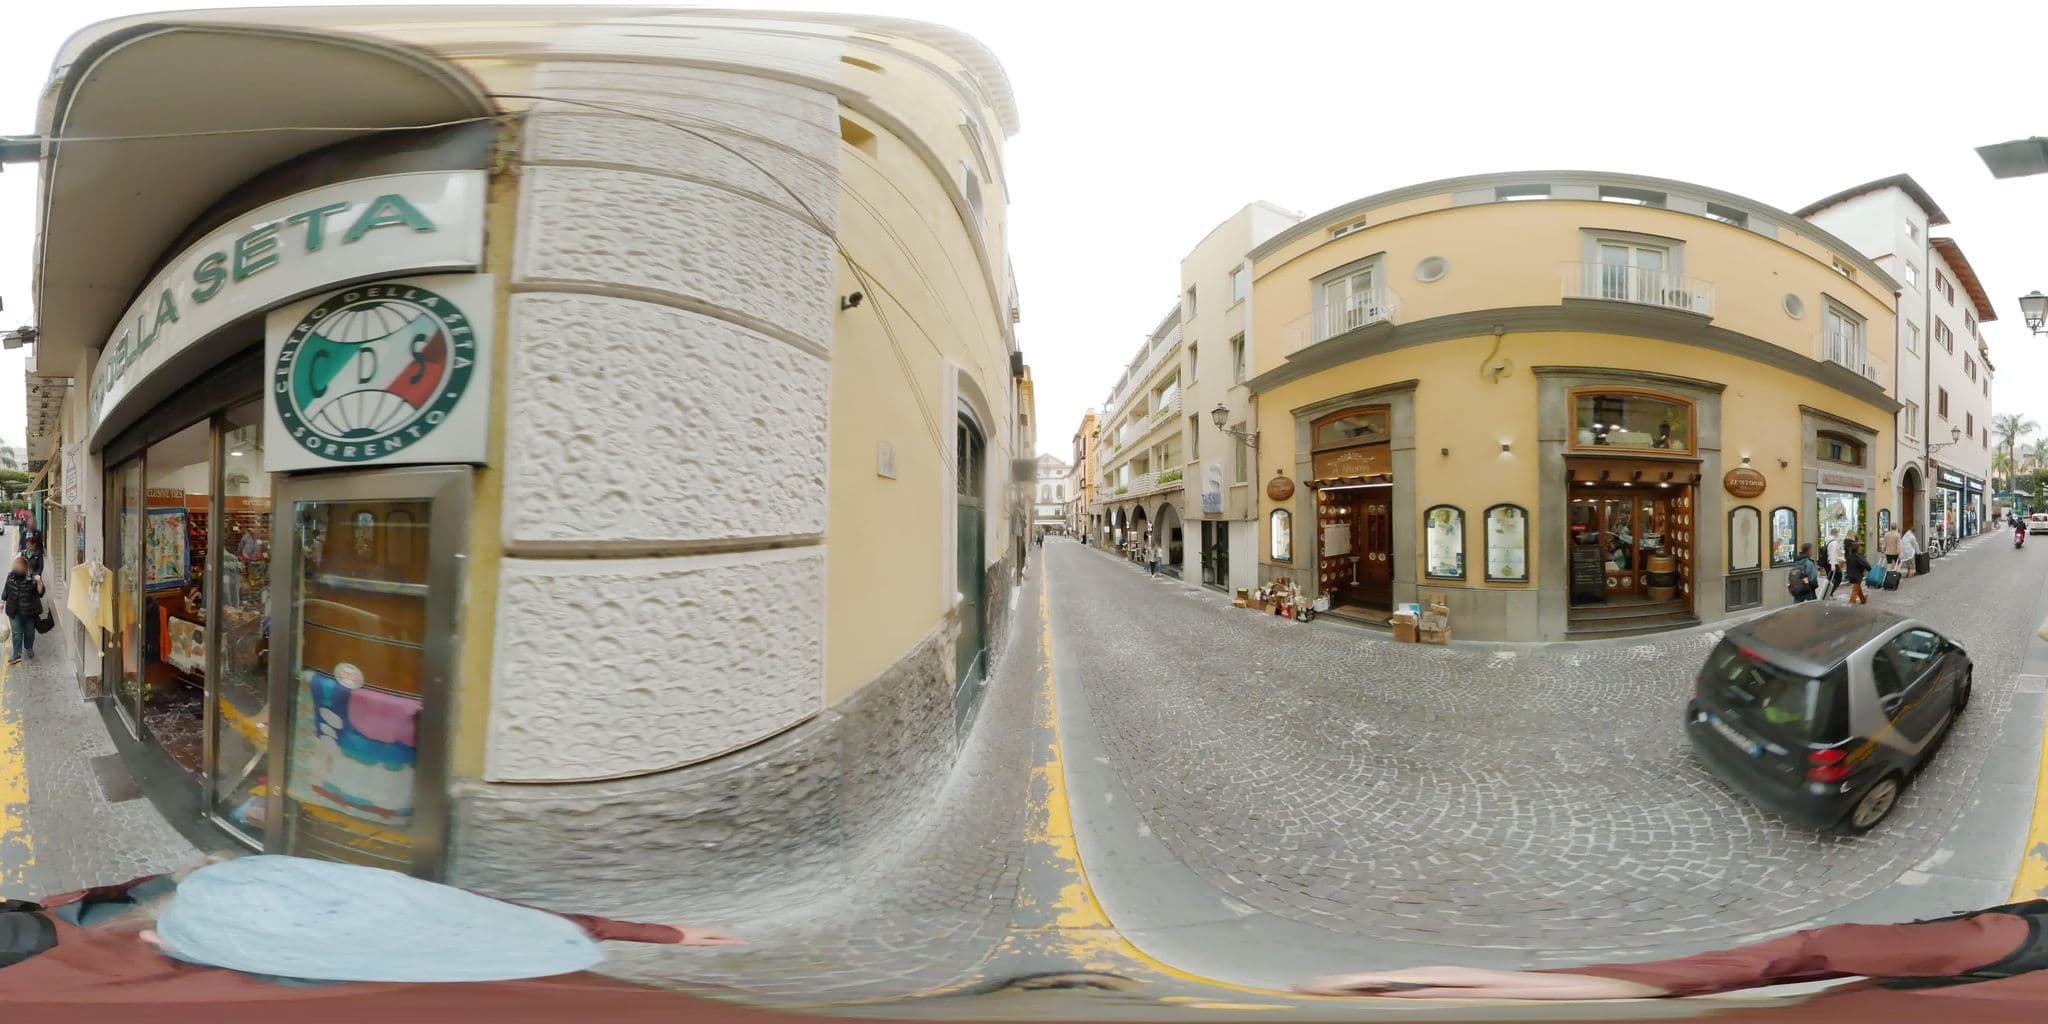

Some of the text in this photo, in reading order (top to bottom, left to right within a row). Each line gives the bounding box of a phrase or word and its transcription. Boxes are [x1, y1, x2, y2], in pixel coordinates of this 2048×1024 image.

[106, 193, 436, 393] DELLA SETA
[276, 286, 473, 393] CENTRO DELLA SETA
[292, 410, 447, 458] SORRENTO
